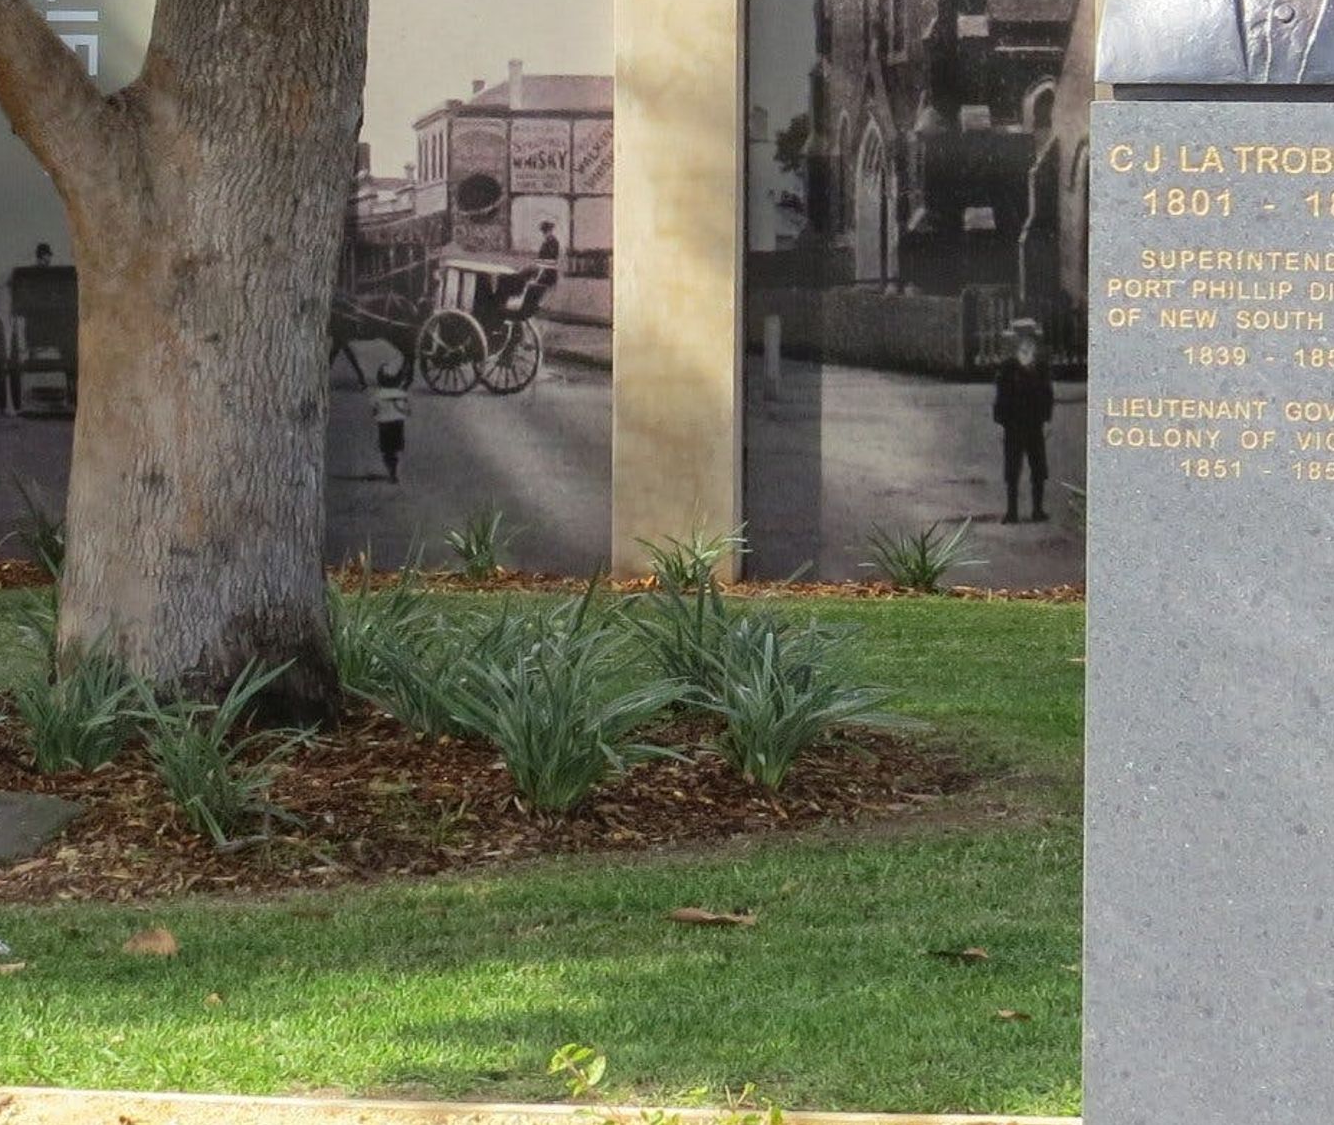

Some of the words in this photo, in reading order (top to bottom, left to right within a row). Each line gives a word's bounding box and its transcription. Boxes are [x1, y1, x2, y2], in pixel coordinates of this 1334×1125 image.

[1110, 145, 1135, 174] C
[1142, 145, 1165, 174] J
[1179, 145, 1225, 175] LA
[1143, 186, 1234, 218] 1801
[1107, 278, 1175, 299] PORT
[1188, 278, 1294, 302] PHILLIP
[1106, 306, 1141, 328] OF
[1158, 307, 1219, 330] NEW
[1234, 308, 1324, 332] SOUTH
[1184, 344, 1249, 367] 1839
[1107, 398, 1267, 421] LIEUTENANT
[1106, 427, 1222, 448] COLONY
[1239, 428, 1275, 450] OF
[1180, 457, 1243, 479] 1851
